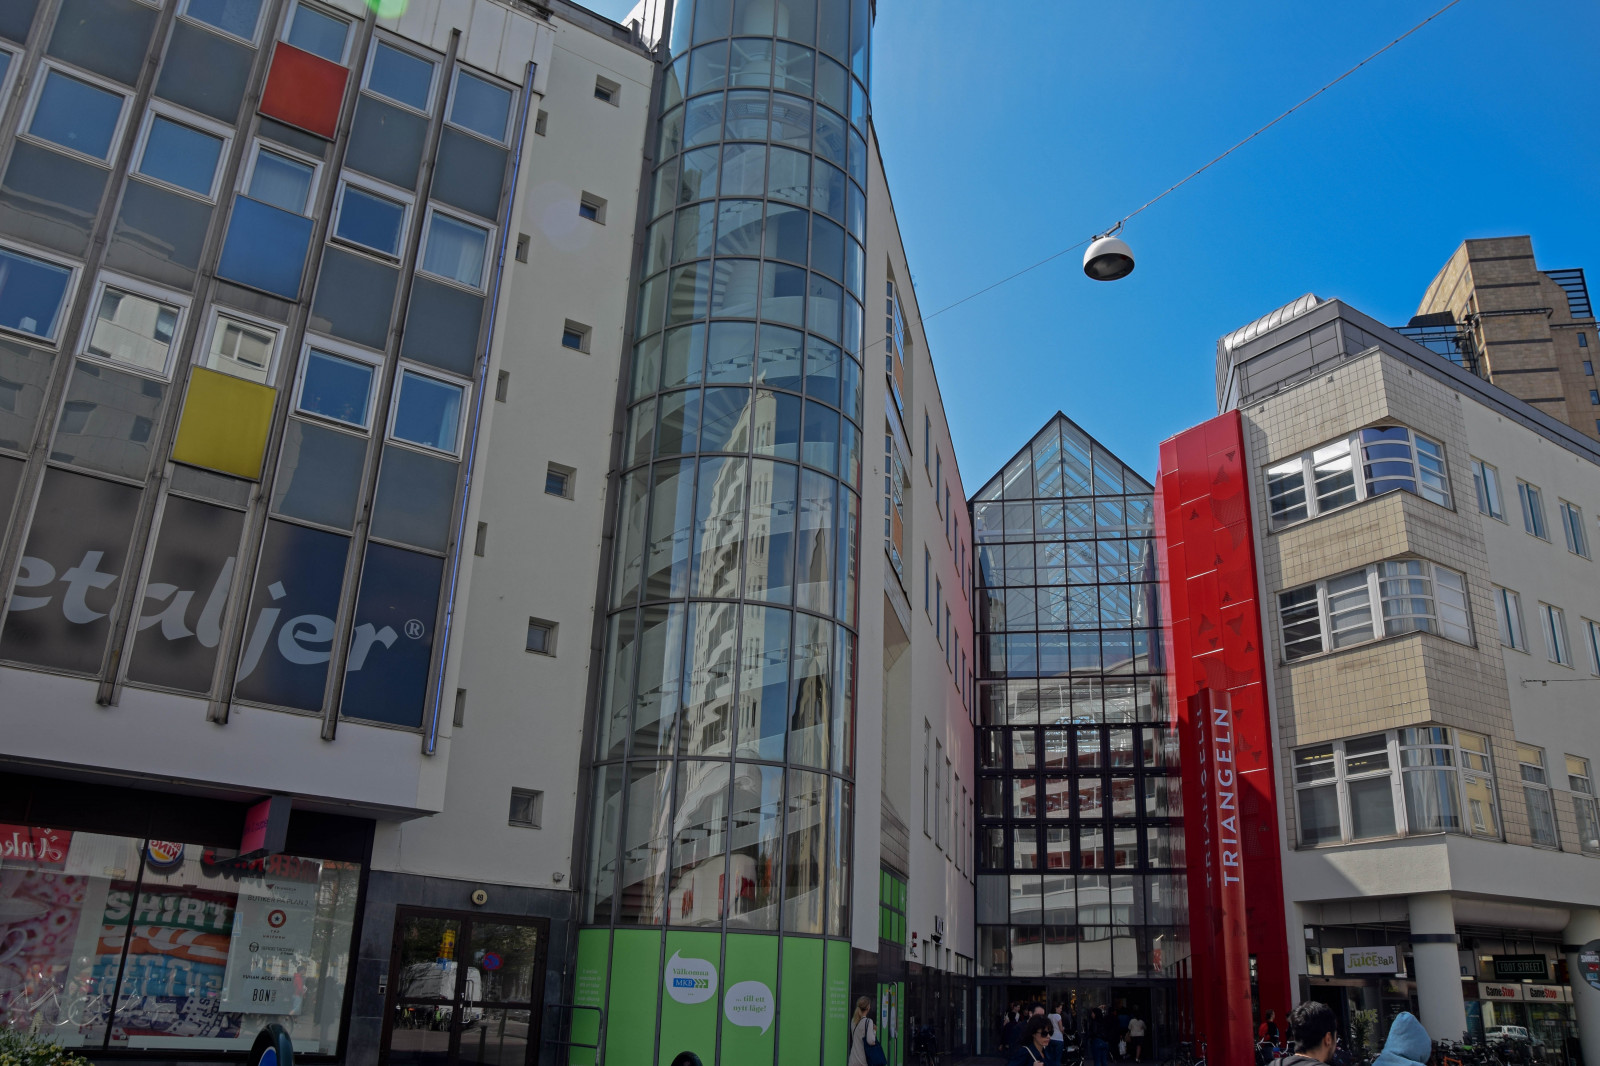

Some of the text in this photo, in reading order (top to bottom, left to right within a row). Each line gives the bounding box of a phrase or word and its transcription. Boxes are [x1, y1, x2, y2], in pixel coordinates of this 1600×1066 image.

[1213, 708, 1240, 887] TRIANGELN
[1500, 962, 1541, 972] FOOT STREET
[675, 979, 693, 987] MKB
[1486, 986, 1515, 998] GameStop
[1530, 987, 1557, 999] GameStop
